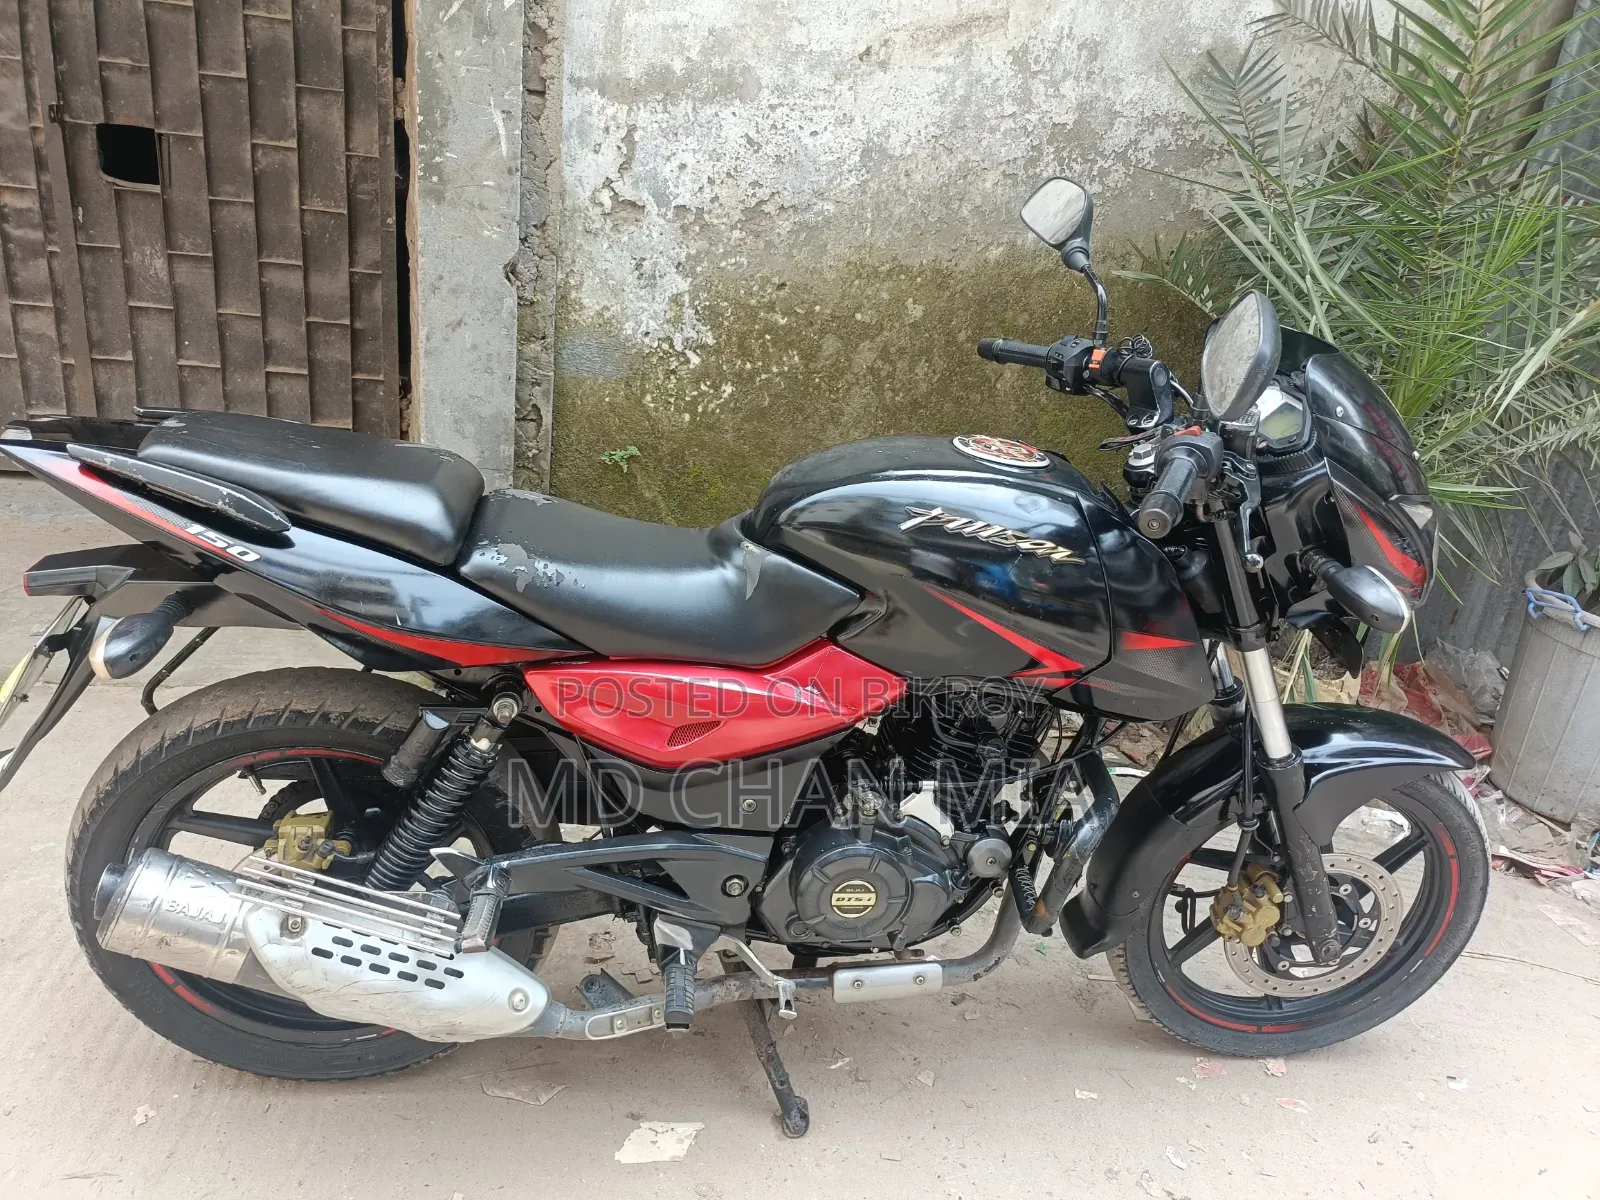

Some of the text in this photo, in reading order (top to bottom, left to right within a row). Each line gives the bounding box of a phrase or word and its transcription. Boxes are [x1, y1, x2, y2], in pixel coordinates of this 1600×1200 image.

[184, 523, 261, 562] 150
[898, 505, 1086, 566] Pulsar
[164, 899, 227, 925] BAJAJ
